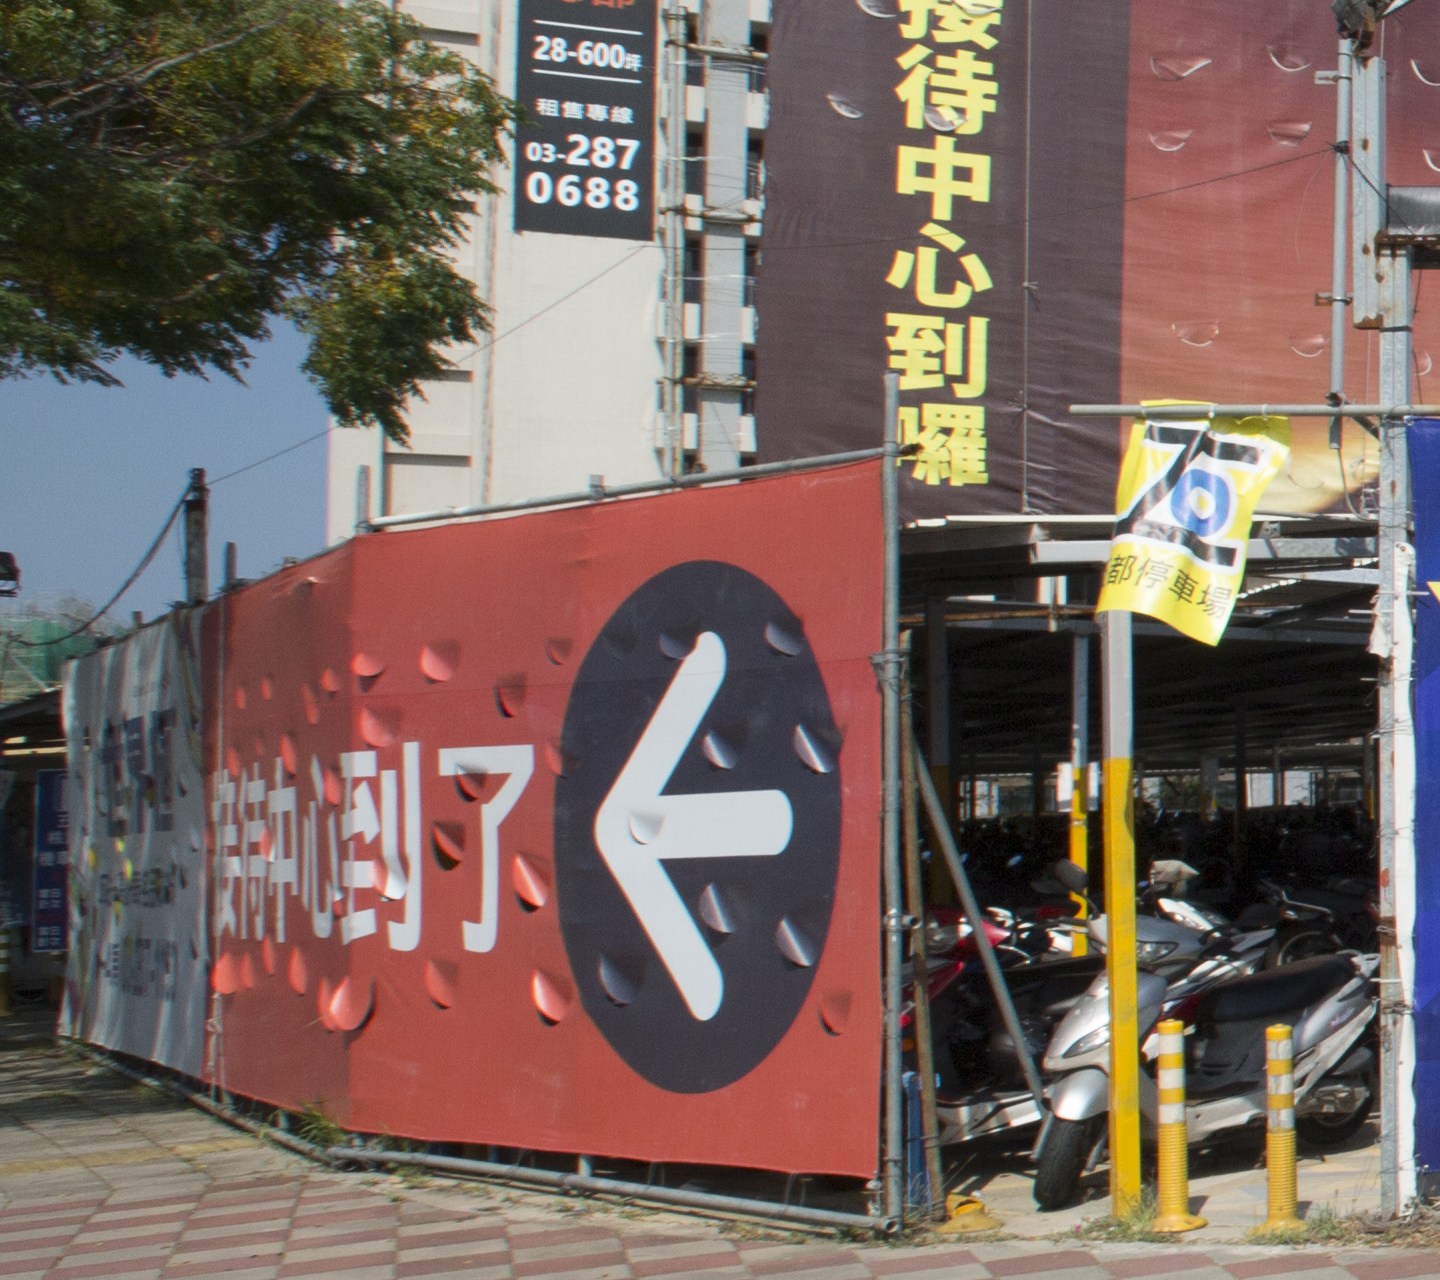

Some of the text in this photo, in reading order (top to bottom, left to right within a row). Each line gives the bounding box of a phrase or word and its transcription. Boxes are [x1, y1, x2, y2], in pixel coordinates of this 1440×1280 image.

[532, 35, 643, 72] 28-600坪
[535, 97, 635, 125] 租售專線
[524, 133, 641, 170] 03-287
[524, 171, 640, 212] 0688
